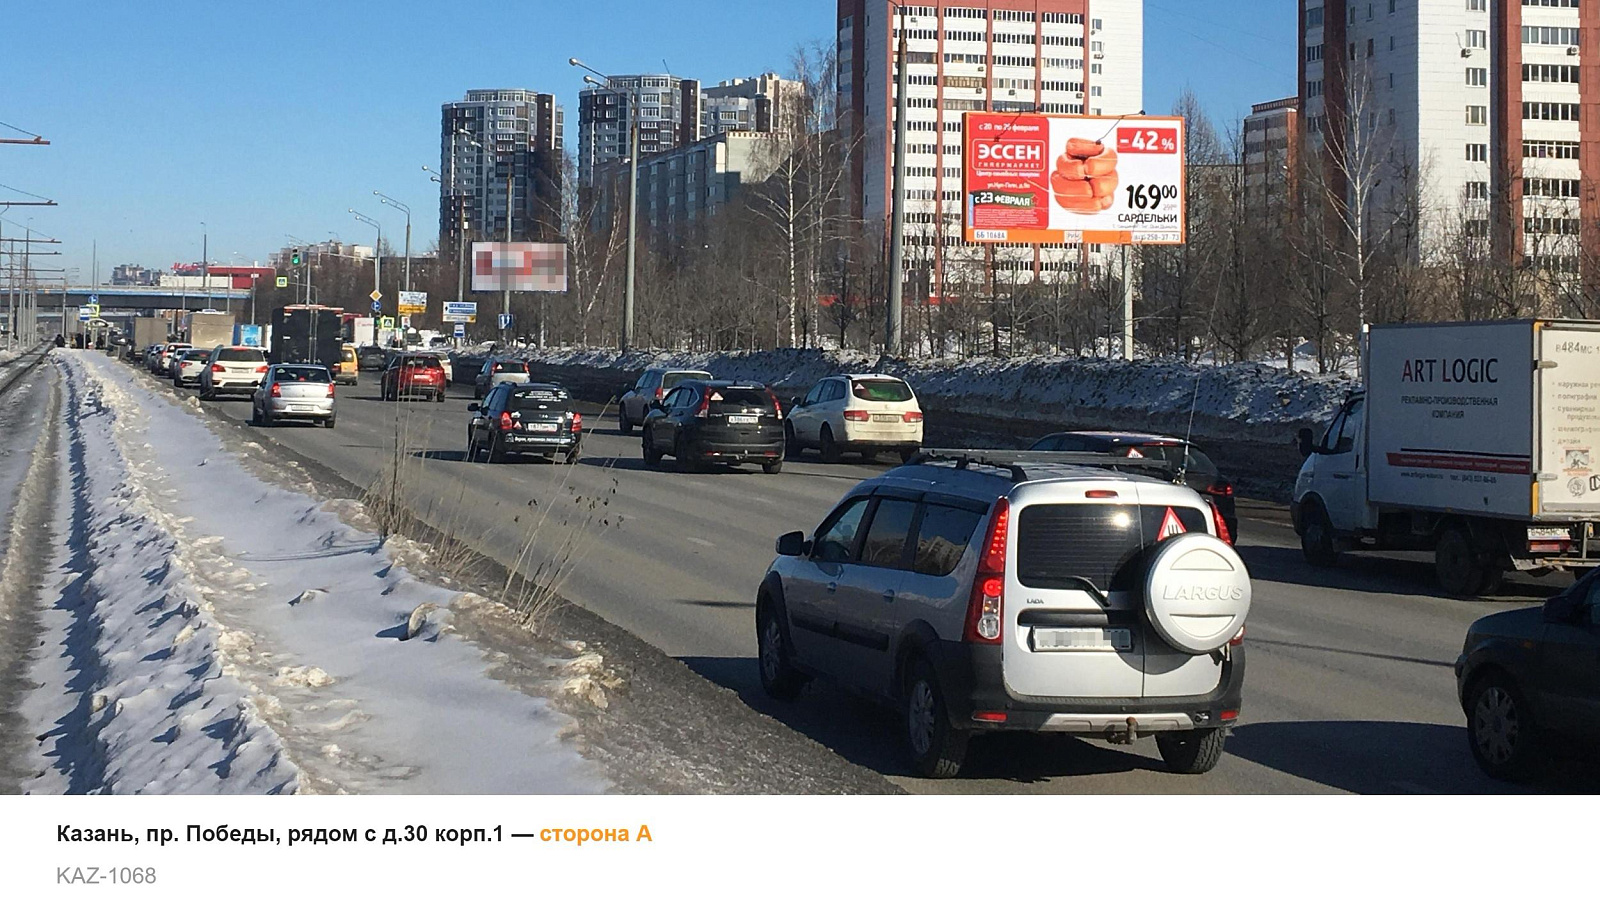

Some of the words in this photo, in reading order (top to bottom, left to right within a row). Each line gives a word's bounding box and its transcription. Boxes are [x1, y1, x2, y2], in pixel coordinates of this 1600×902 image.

[978, 144, 1040, 160] ЭССЕН
[980, 191, 994, 204] 23
[994, 195, 1031, 207] ФЕВРАЛЯ
[1118, 213, 1177, 224] САРДЕЛЬКИ
[1402, 358, 1437, 382] ART
[1442, 358, 1499, 383] LOGIC
[1162, 584, 1244, 601] LARGUS
